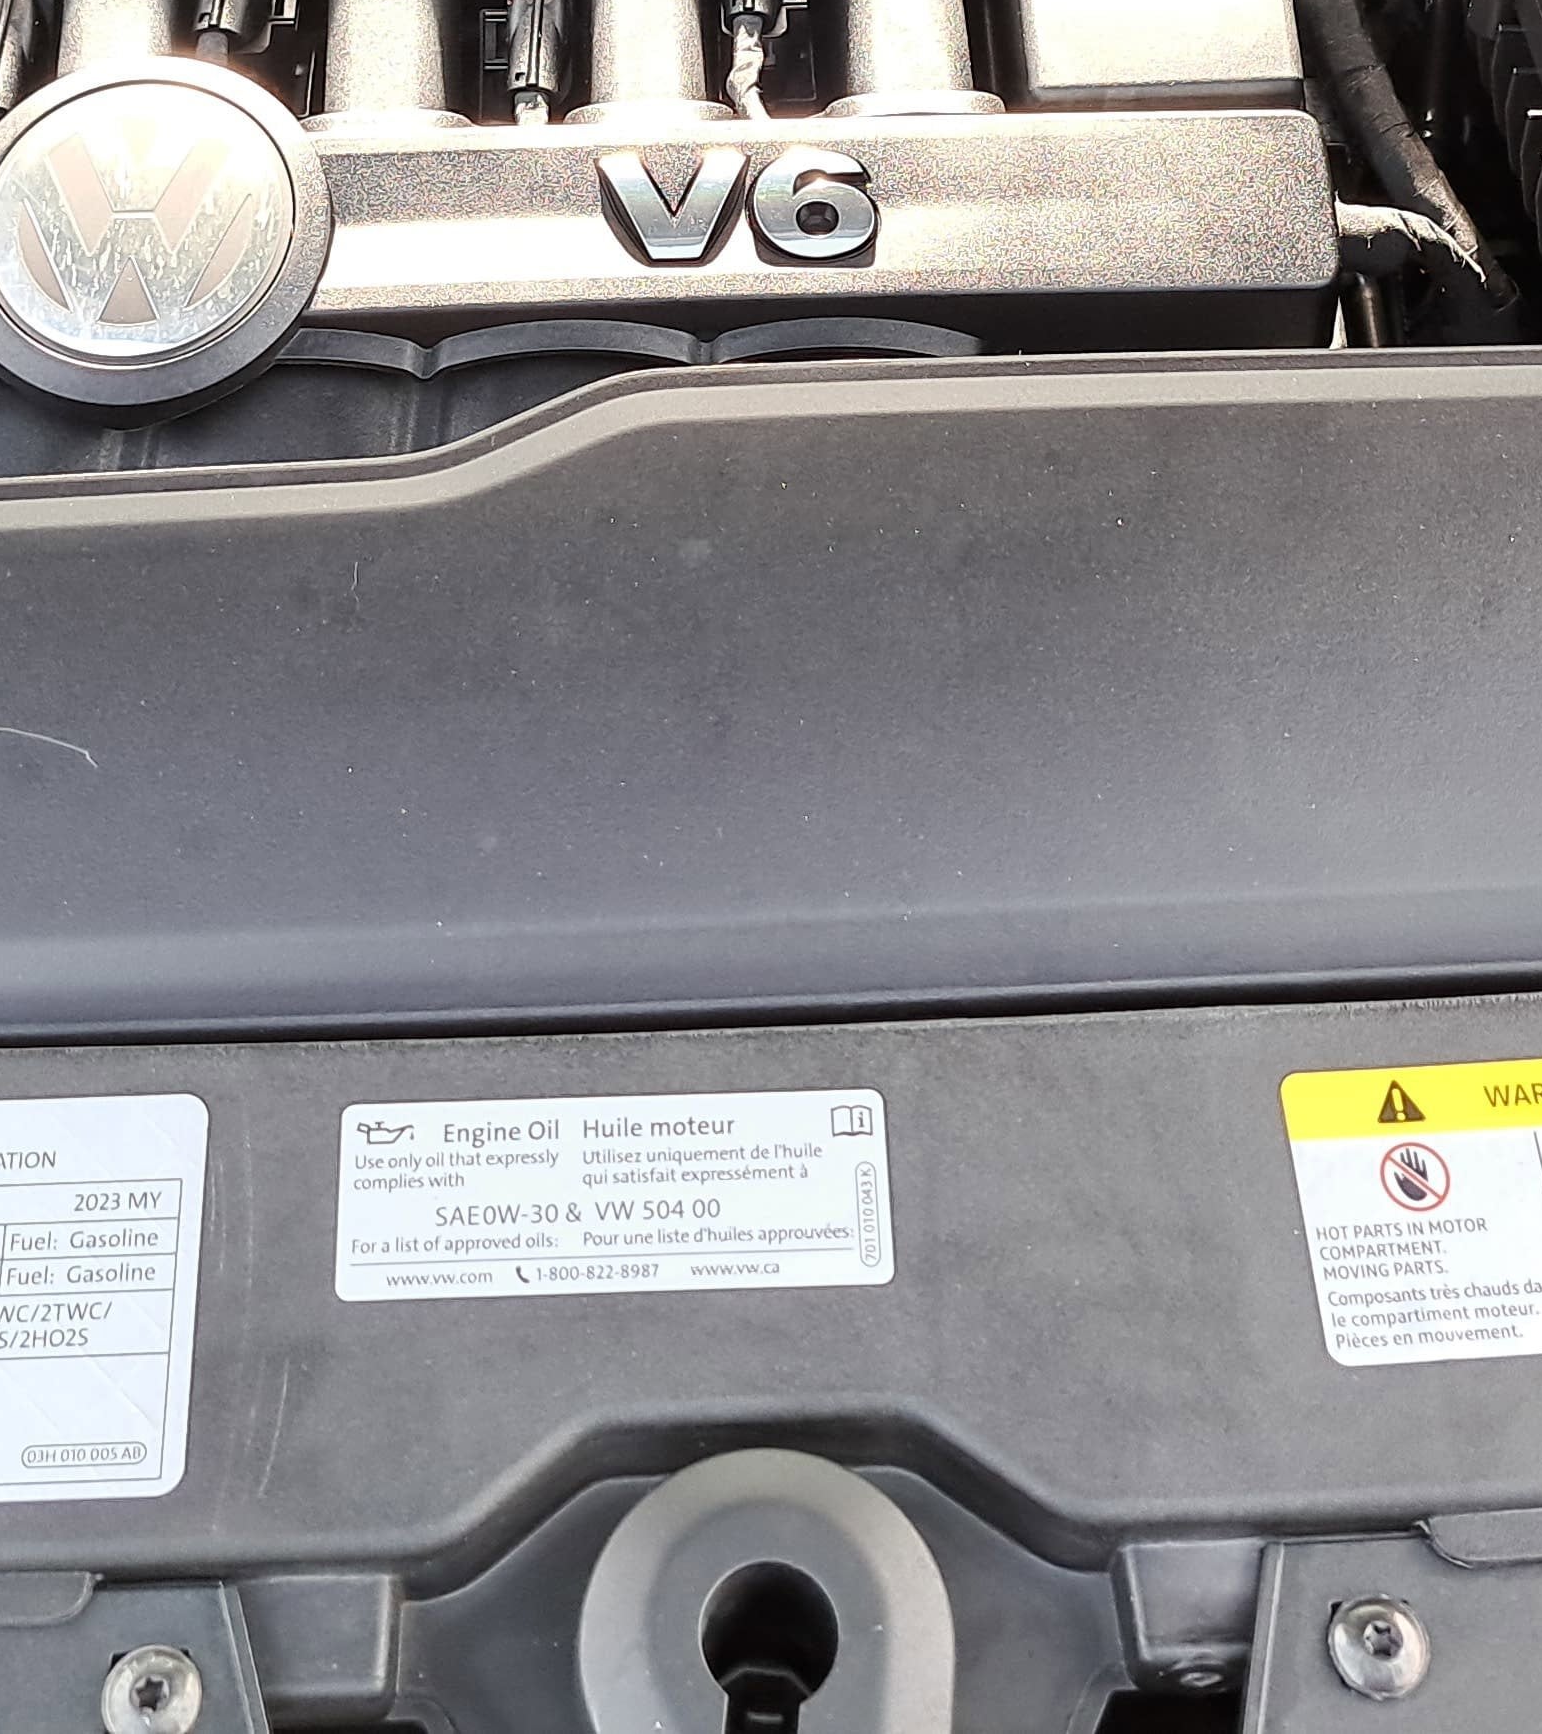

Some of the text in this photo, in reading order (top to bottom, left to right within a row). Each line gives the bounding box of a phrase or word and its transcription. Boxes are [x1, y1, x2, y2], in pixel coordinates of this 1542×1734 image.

[596, 145, 883, 268] V6
[443, 1117, 560, 1147] Engine Oil
[582, 1115, 736, 1139] Huile moteur
[354, 1147, 560, 1172] Use only oil that expressly
[582, 1141, 823, 1166] Utilisez uniquement de l'huile
[352, 1171, 465, 1192] complies with
[581, 1168, 608, 1186] qui
[612, 1167, 677, 1185] satisfait
[73, 1190, 163, 1213] 2023 MY
[434, 1197, 722, 1227] SAE0W-30 & VW 504 00
[10, 1227, 159, 1253] Fuel: Gasoline
[582, 1231, 620, 1247] Pour
[623, 1232, 654, 1246] une
[657, 1227, 690, 1245] liste
[693, 1225, 754, 1243] d'huiles
[1315, 1217, 1489, 1241] HOT PARTS IN MOTOR
[351, 1231, 559, 1255] For a list of approved oils:
[1319, 1239, 1448, 1261] COMPARTMENT.
[6, 1261, 156, 1287] Fuel: Gasoline
[386, 1271, 494, 1287] www.vw.com
[536, 1263, 660, 1282] 1-800-822-8987
[1322, 1259, 1450, 1281] MOVING PARTS.
[1327, 1287, 1428, 1307] Composants
[1463, 1279, 1520, 1299] chauds
[1330, 1303, 1541, 1328] le compartiment moteur.
[1392, 1332, 1414, 1346] en
[1417, 1323, 1524, 1345] mouvement.
